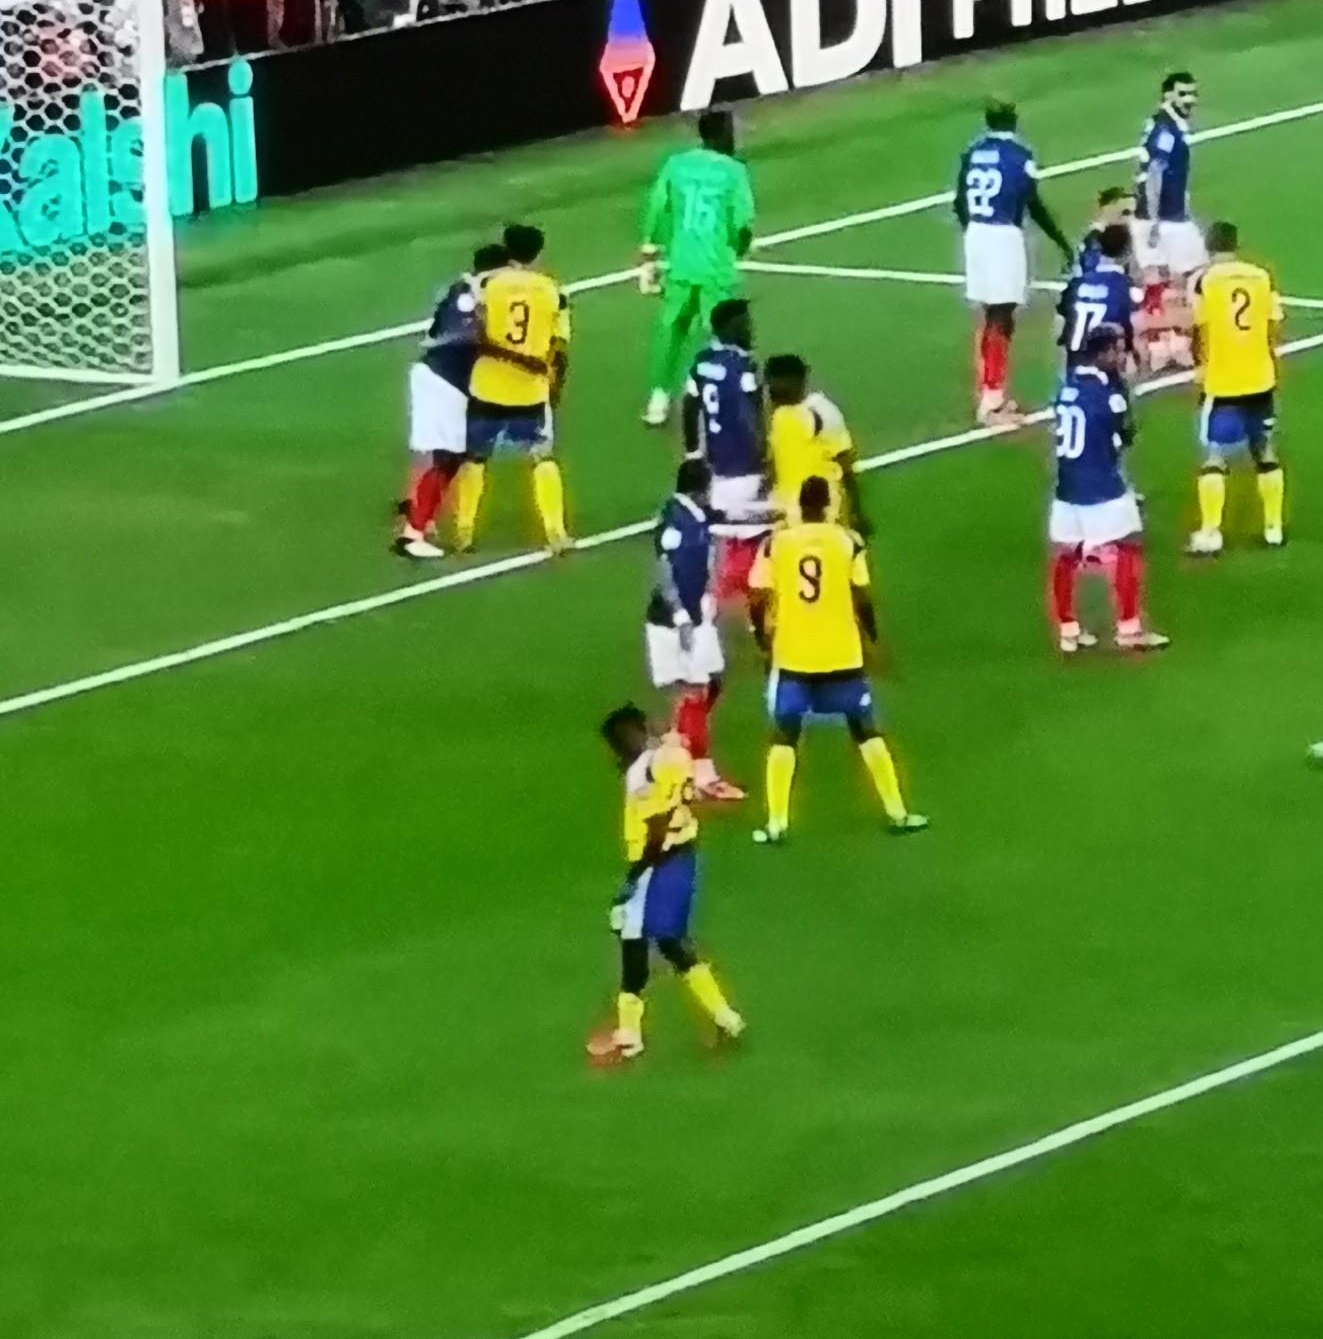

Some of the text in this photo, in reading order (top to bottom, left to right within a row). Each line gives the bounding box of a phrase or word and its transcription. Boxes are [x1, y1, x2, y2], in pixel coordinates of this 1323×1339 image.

[506, 301, 529, 344] 3
[1231, 287, 1251, 331] 2
[799, 554, 822, 603] 9
